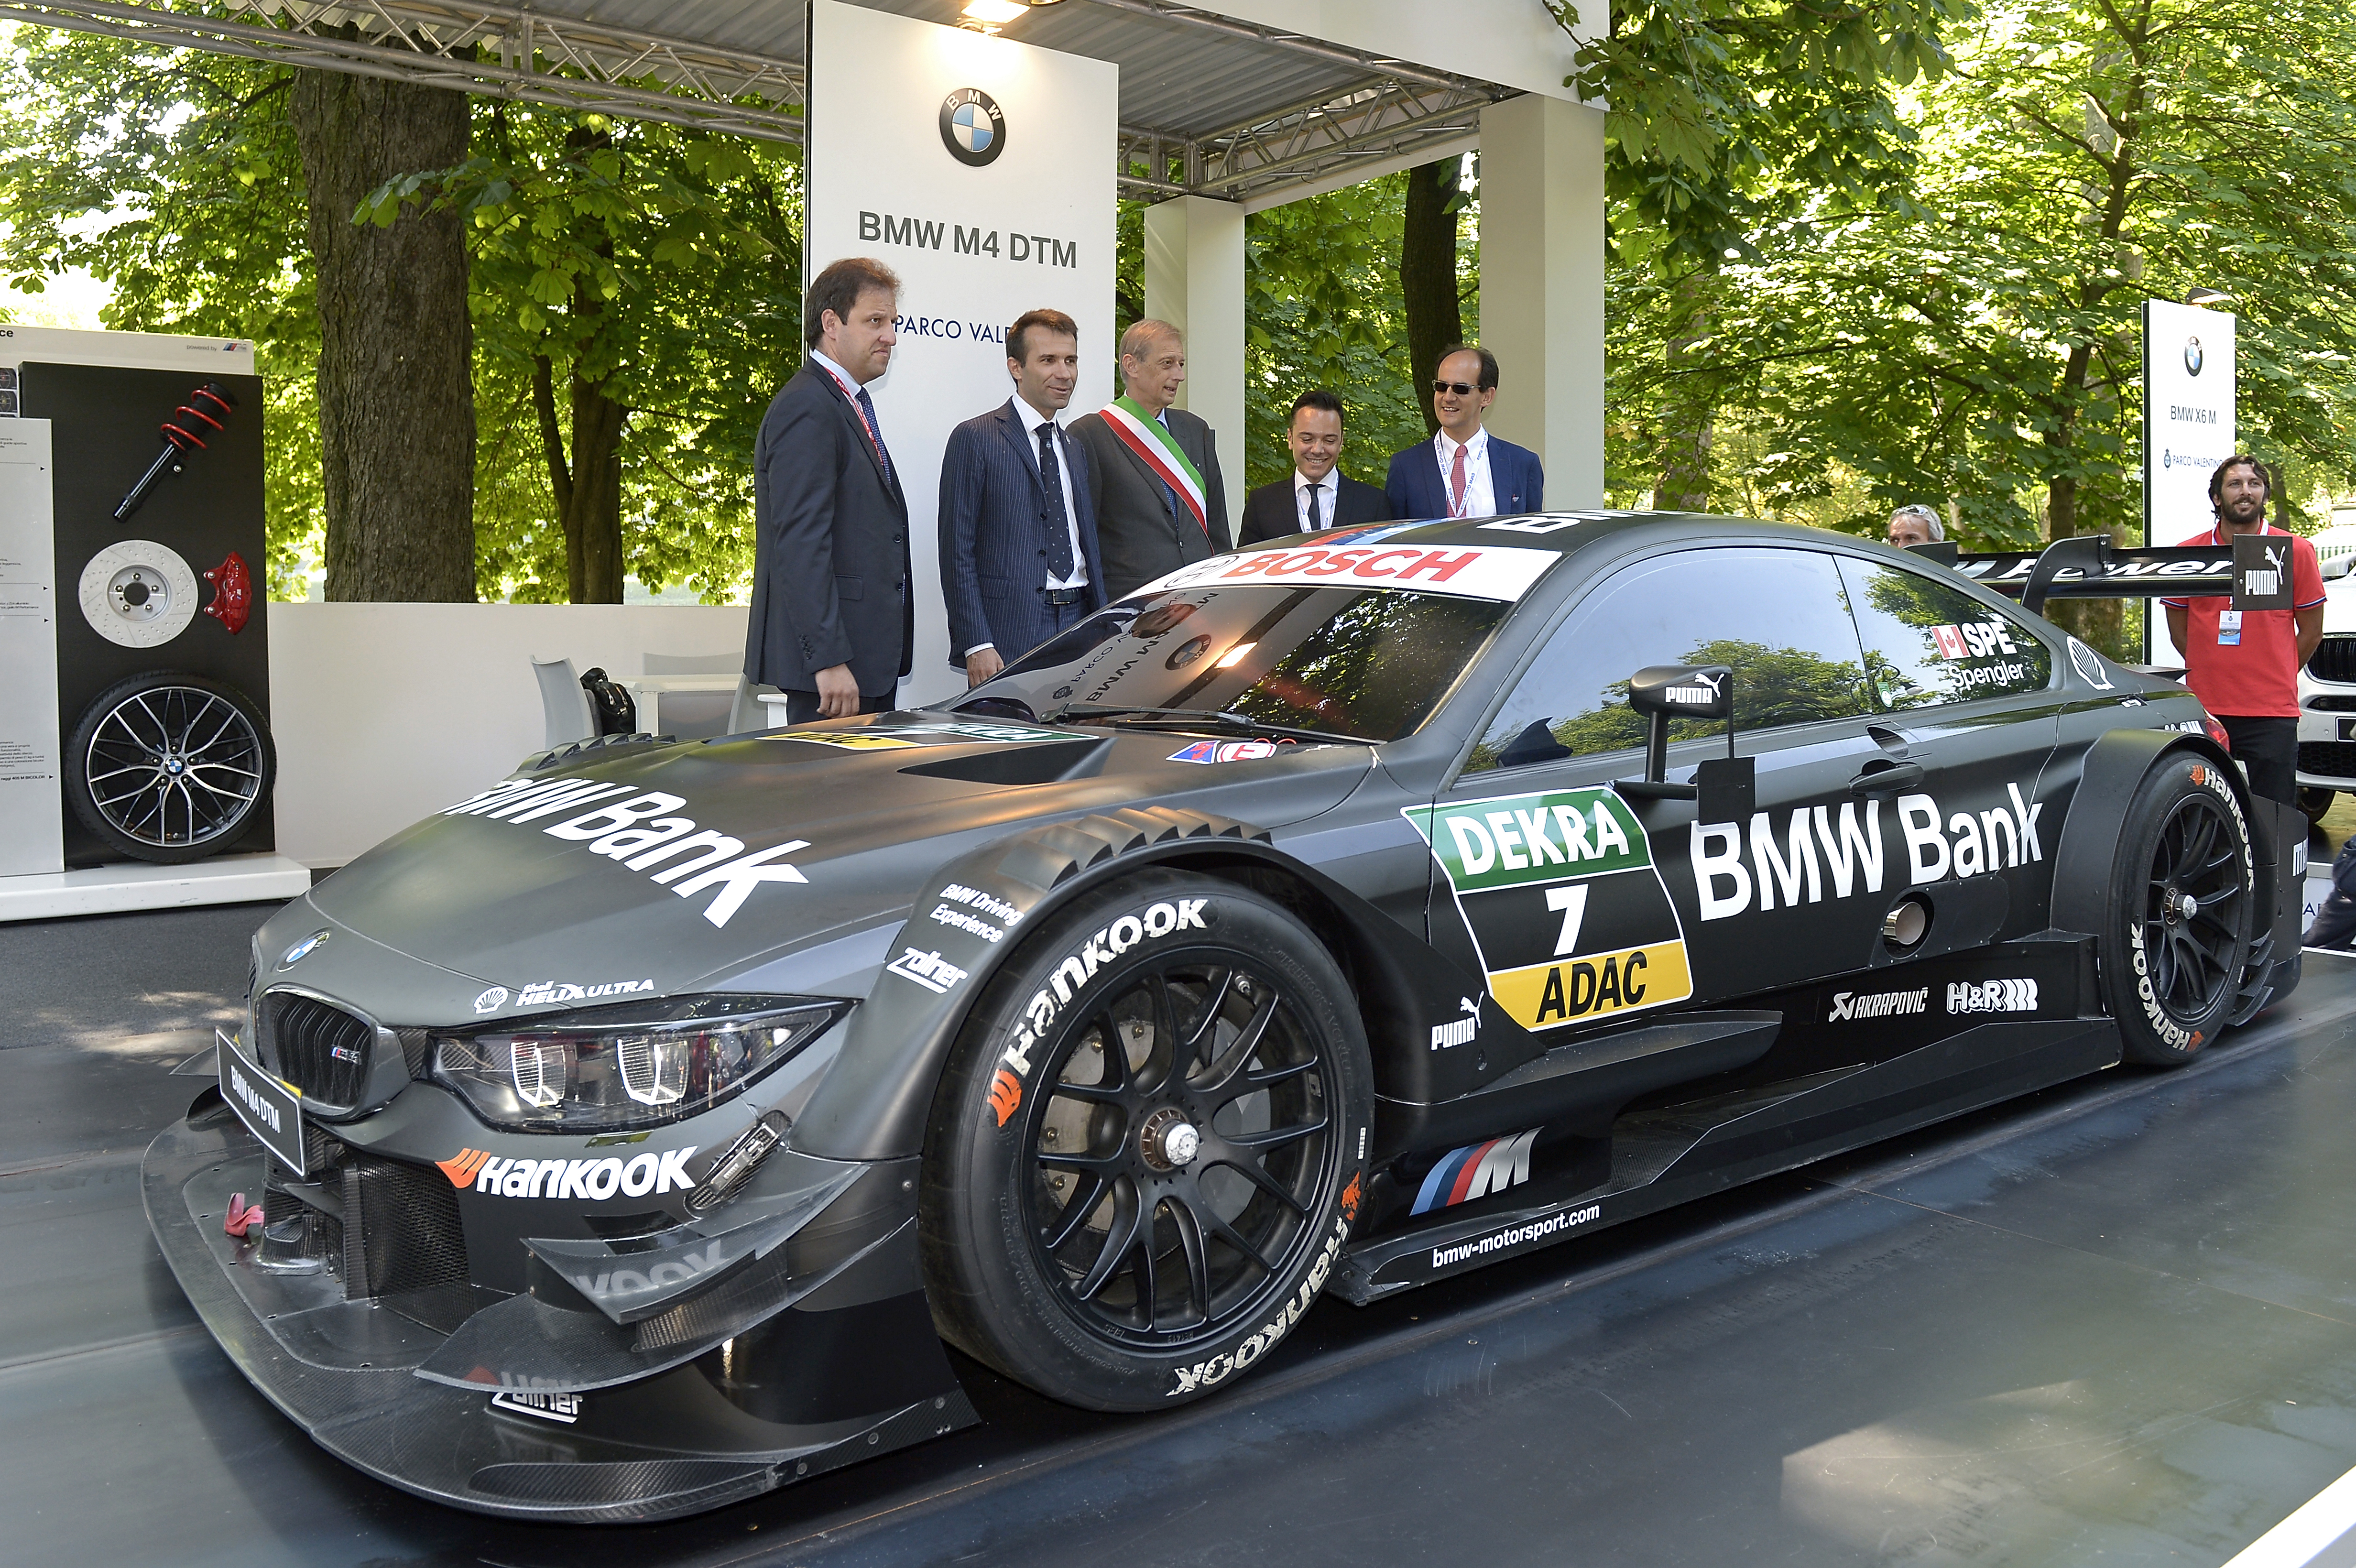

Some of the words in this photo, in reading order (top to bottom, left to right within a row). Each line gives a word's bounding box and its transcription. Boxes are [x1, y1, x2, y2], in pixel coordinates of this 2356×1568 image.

[946, 89, 1003, 121] BMW
[859, 211, 945, 250] BMW
[954, 225, 1000, 258] M4
[1010, 233, 1077, 269] DTM
[894, 315, 962, 339] PARCO
[2171, 405, 2193, 422] BMW
[2195, 408, 2206, 424] X6
[2209, 410, 2216, 425] M
[2173, 455, 2192, 466] PARCO
[2193, 457, 2223, 468] VALENTINO
[1220, 550, 1483, 582] BOSCH
[2245, 569, 2278, 596] PUMA
[1961, 621, 2018, 658] SPE
[1948, 660, 2024, 691] Spengler
[1665, 686, 1713, 705] PUMA
[435, 777, 639, 825] BMW
[542, 791, 811, 929] Bank
[1445, 799, 1630, 876] DEKRA
[1690, 799, 1884, 922] BMW
[1897, 783, 2043, 886] Bank
[939, 883, 981, 904] BMW
[970, 892, 1025, 927] Driving
[1544, 883, 1590, 957] 7
[929, 903, 1004, 943] Experience
[515, 983, 586, 1007] HELIX
[586, 979, 655, 998] ULTRA
[522, 980, 555, 994] Shell
[1535, 951, 1648, 1024] ADAC
[1854, 986, 1929, 1020] AKRAPOVIČ
[1947, 978, 2008, 1014] H&R
[1430, 1016, 1475, 1051] PUMA
[230, 1065, 248, 1104] BMW
[247, 1086, 260, 1116] M4
[259, 1096, 281, 1133] DTM
[1433, 1203, 1600, 1268] bmw-motorsport.com
